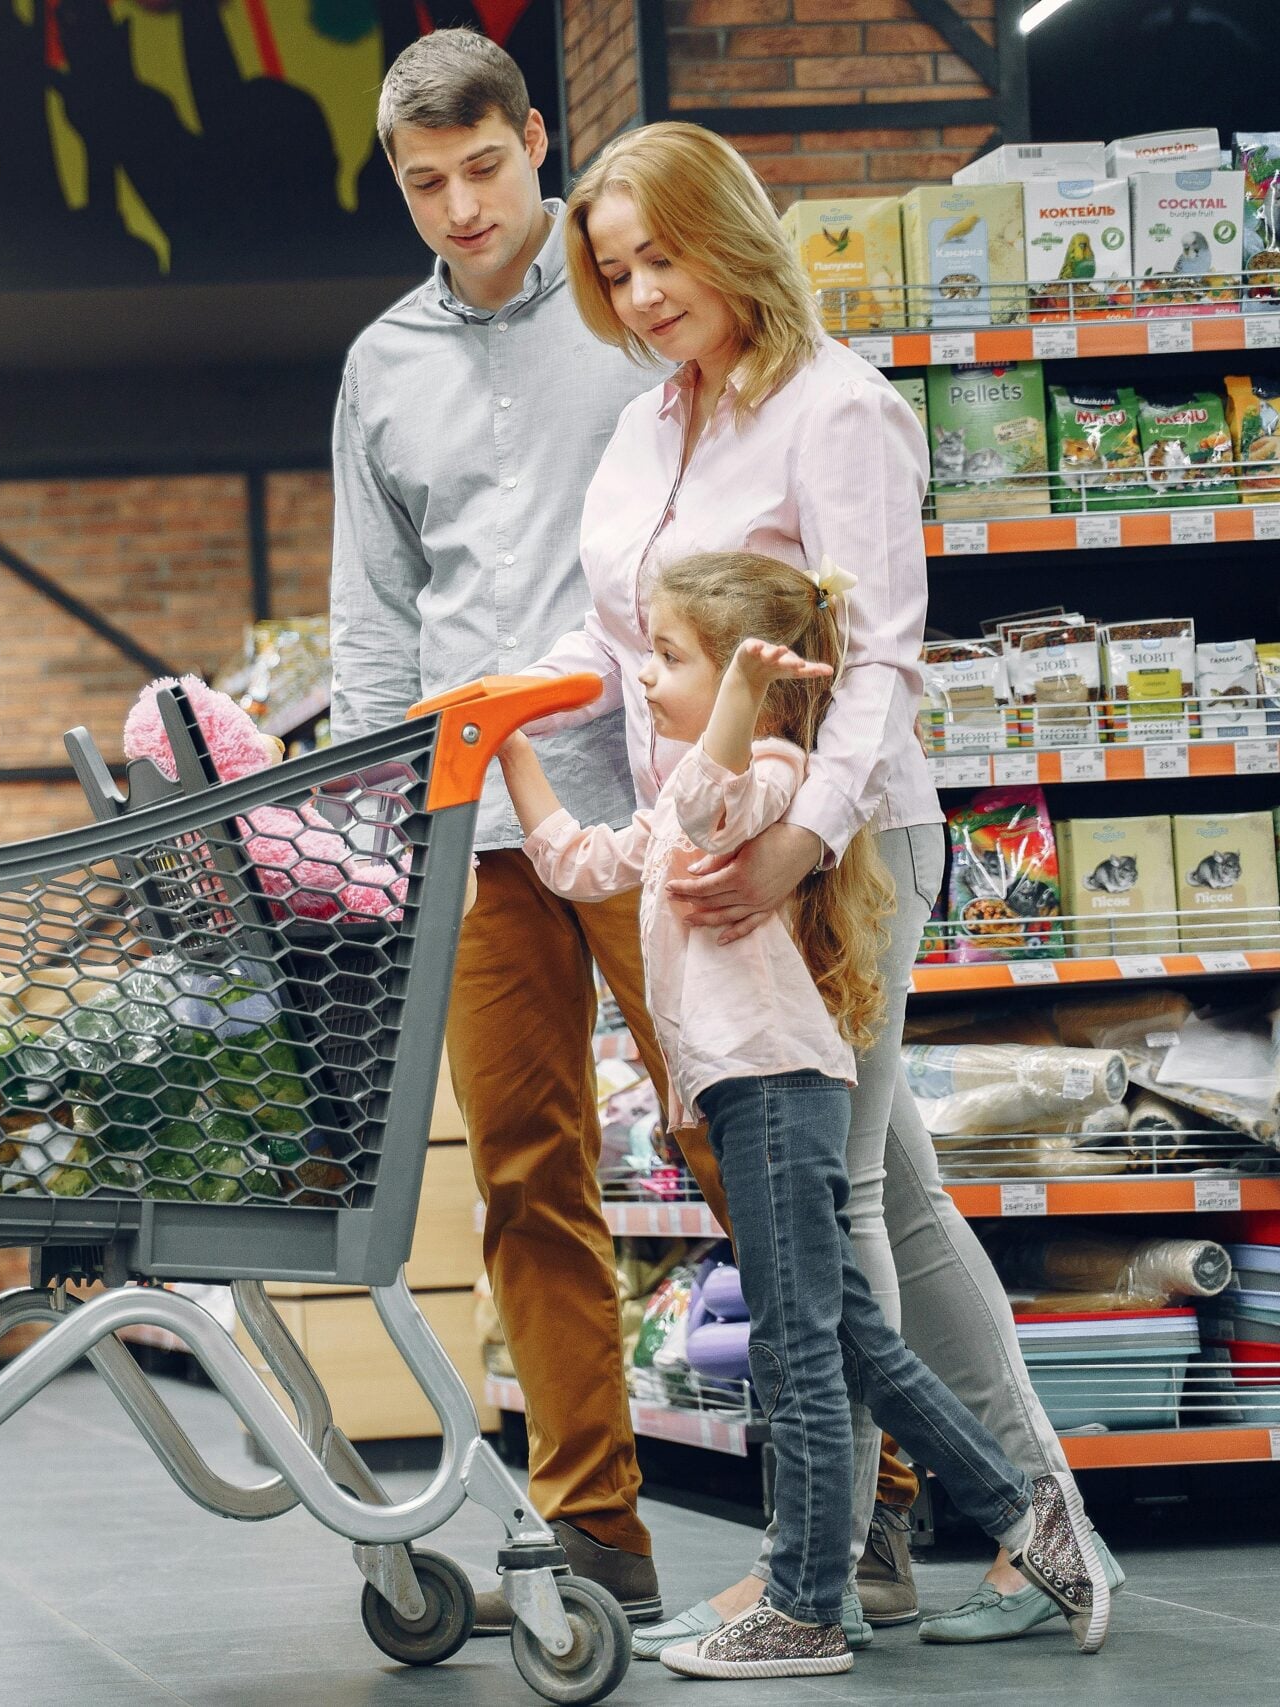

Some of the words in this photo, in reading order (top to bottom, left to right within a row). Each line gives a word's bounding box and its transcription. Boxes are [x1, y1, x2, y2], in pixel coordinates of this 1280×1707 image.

[1157, 198, 1227, 210] COCKTAIL
[1039, 204, 1116, 219] КОКТЕЙЛЬ
[1169, 210, 1197, 219] budgie
[950, 383, 1023, 405] Pellets
